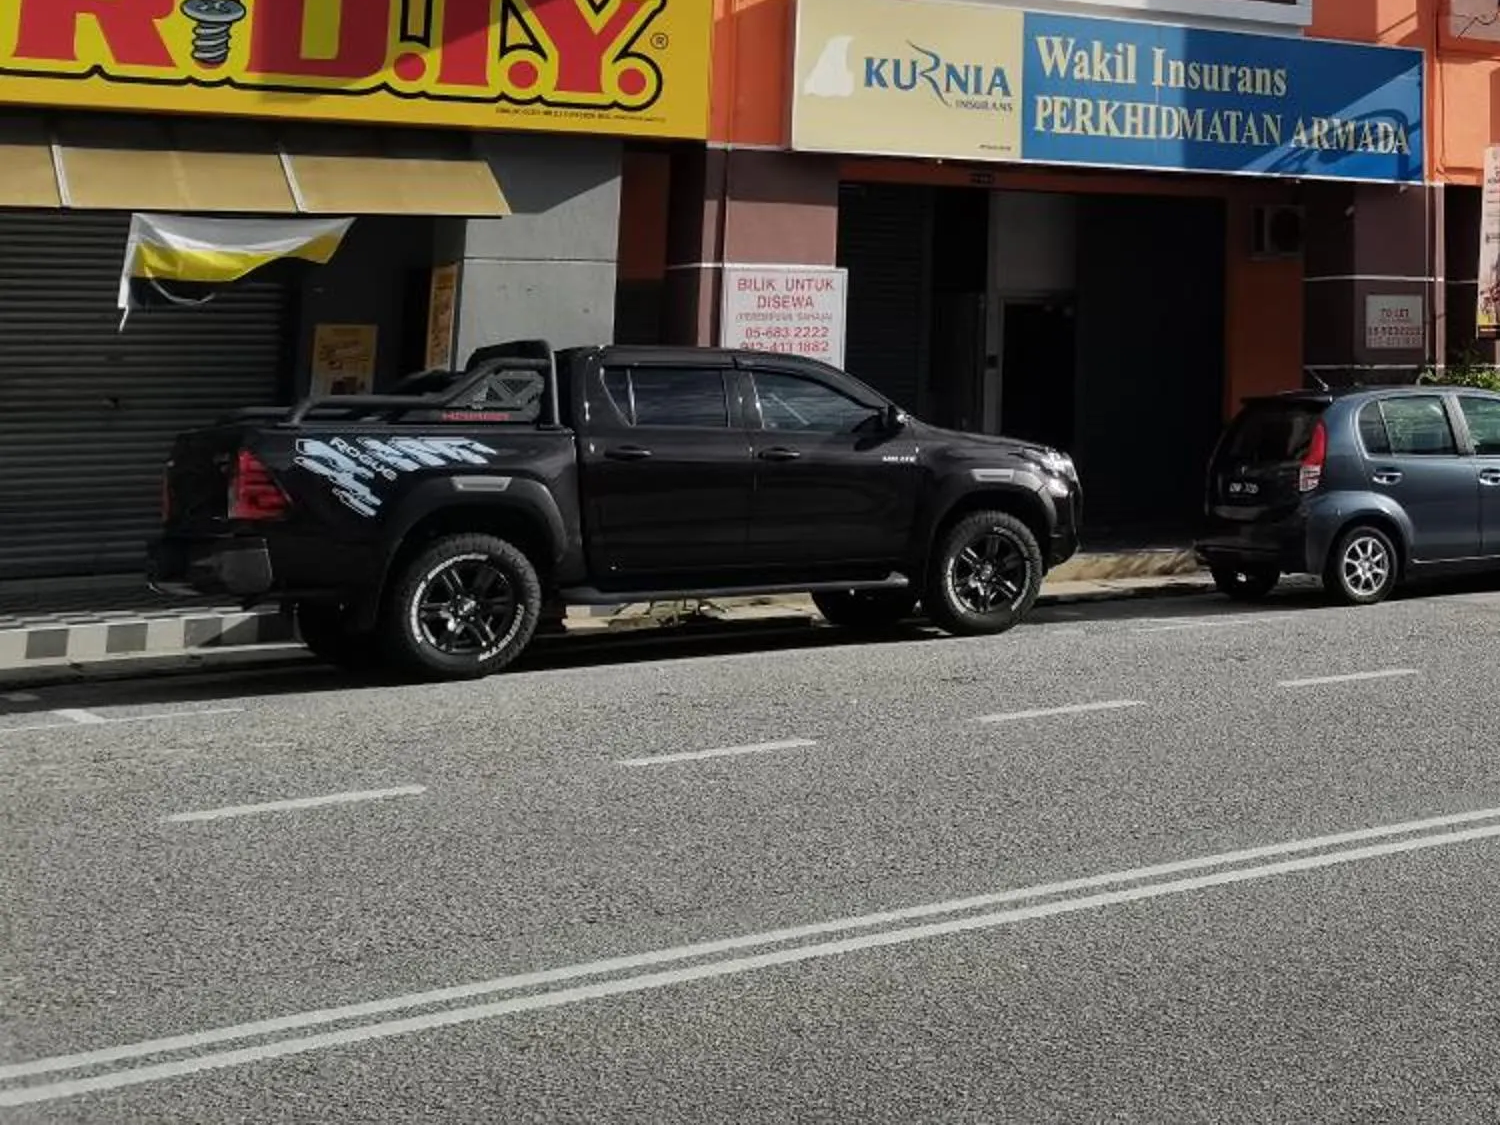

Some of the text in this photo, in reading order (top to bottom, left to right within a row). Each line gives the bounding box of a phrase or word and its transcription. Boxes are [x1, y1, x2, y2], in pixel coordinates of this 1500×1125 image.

[863, 40, 1013, 107] KURNIA
[1035, 35, 1288, 97] Wakil Insurans
[1033, 95, 1411, 156] PERKHIDMATAN ARMADA
[736, 277, 835, 292] BILIK UNTUK
[756, 294, 815, 309] DISEWA
[794, 325, 830, 339] 2222
